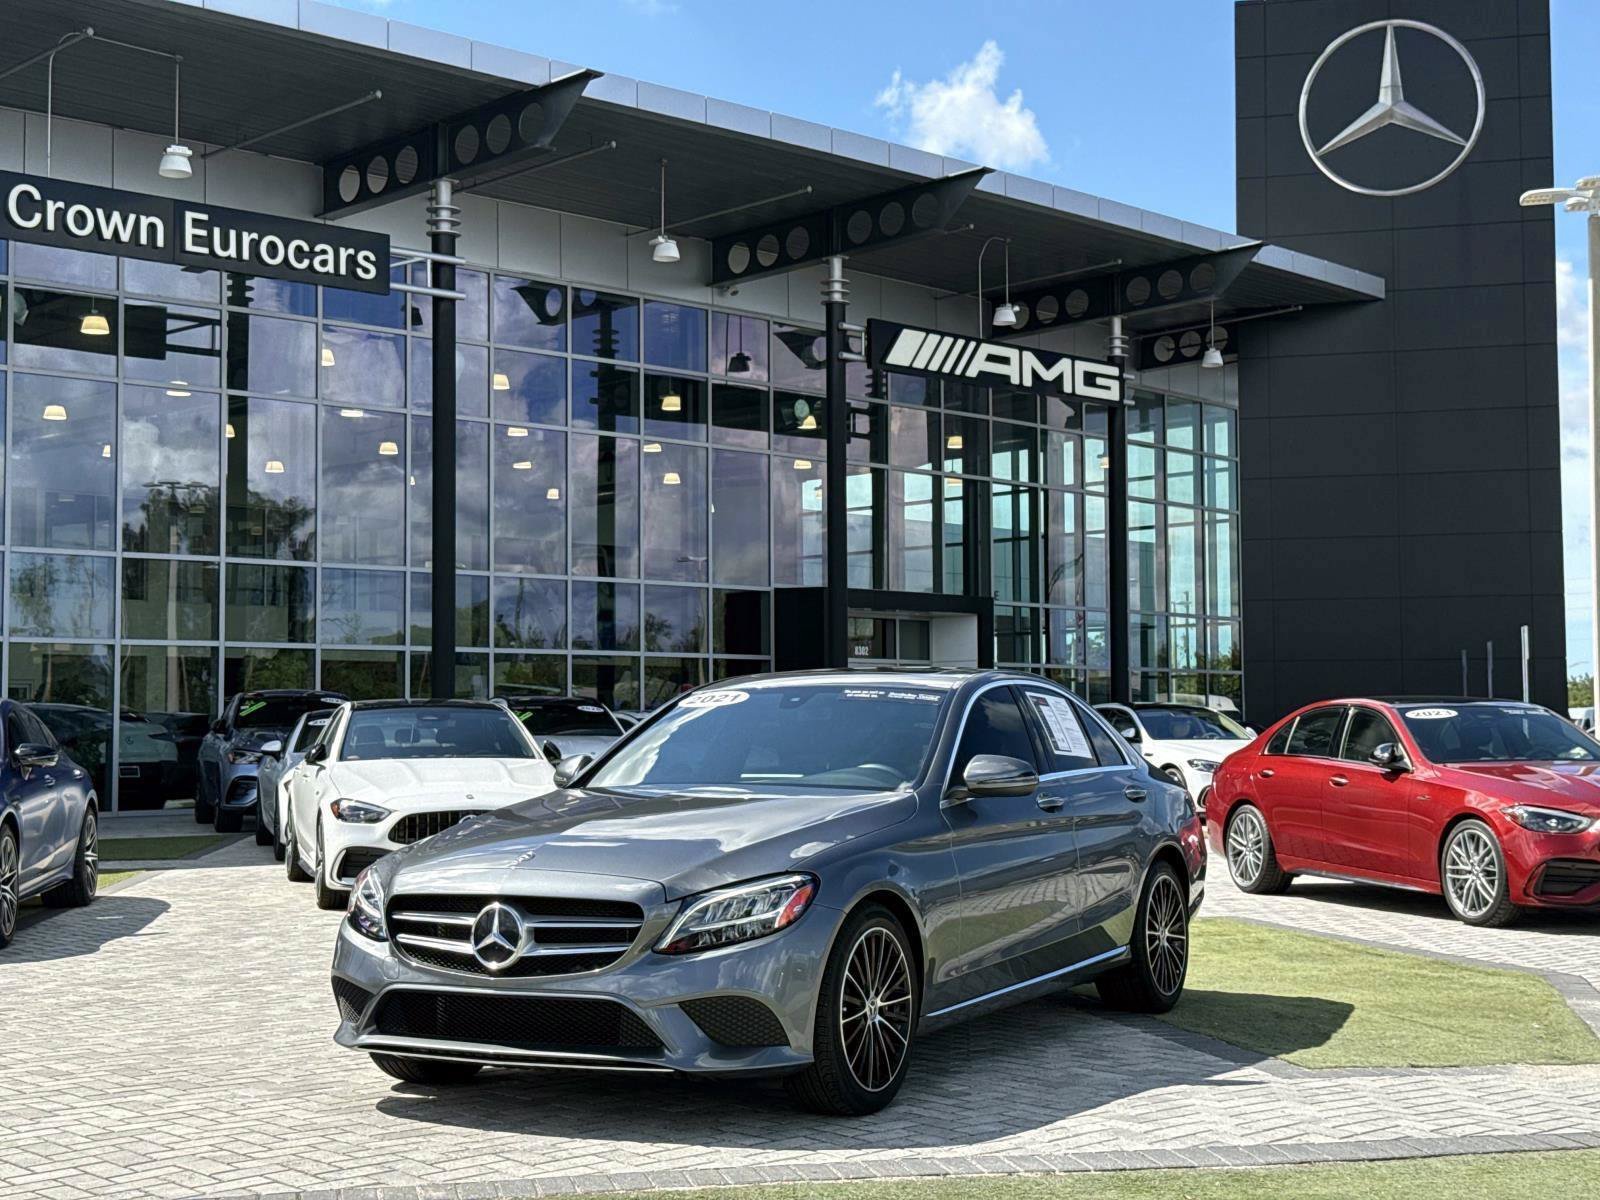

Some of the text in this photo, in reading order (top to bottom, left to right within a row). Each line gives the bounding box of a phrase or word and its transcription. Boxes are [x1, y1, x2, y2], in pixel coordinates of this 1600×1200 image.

[7, 183, 378, 281] Crown Eurocars
[964, 342, 1120, 402] AMG
[684, 692, 742, 705] 2021
